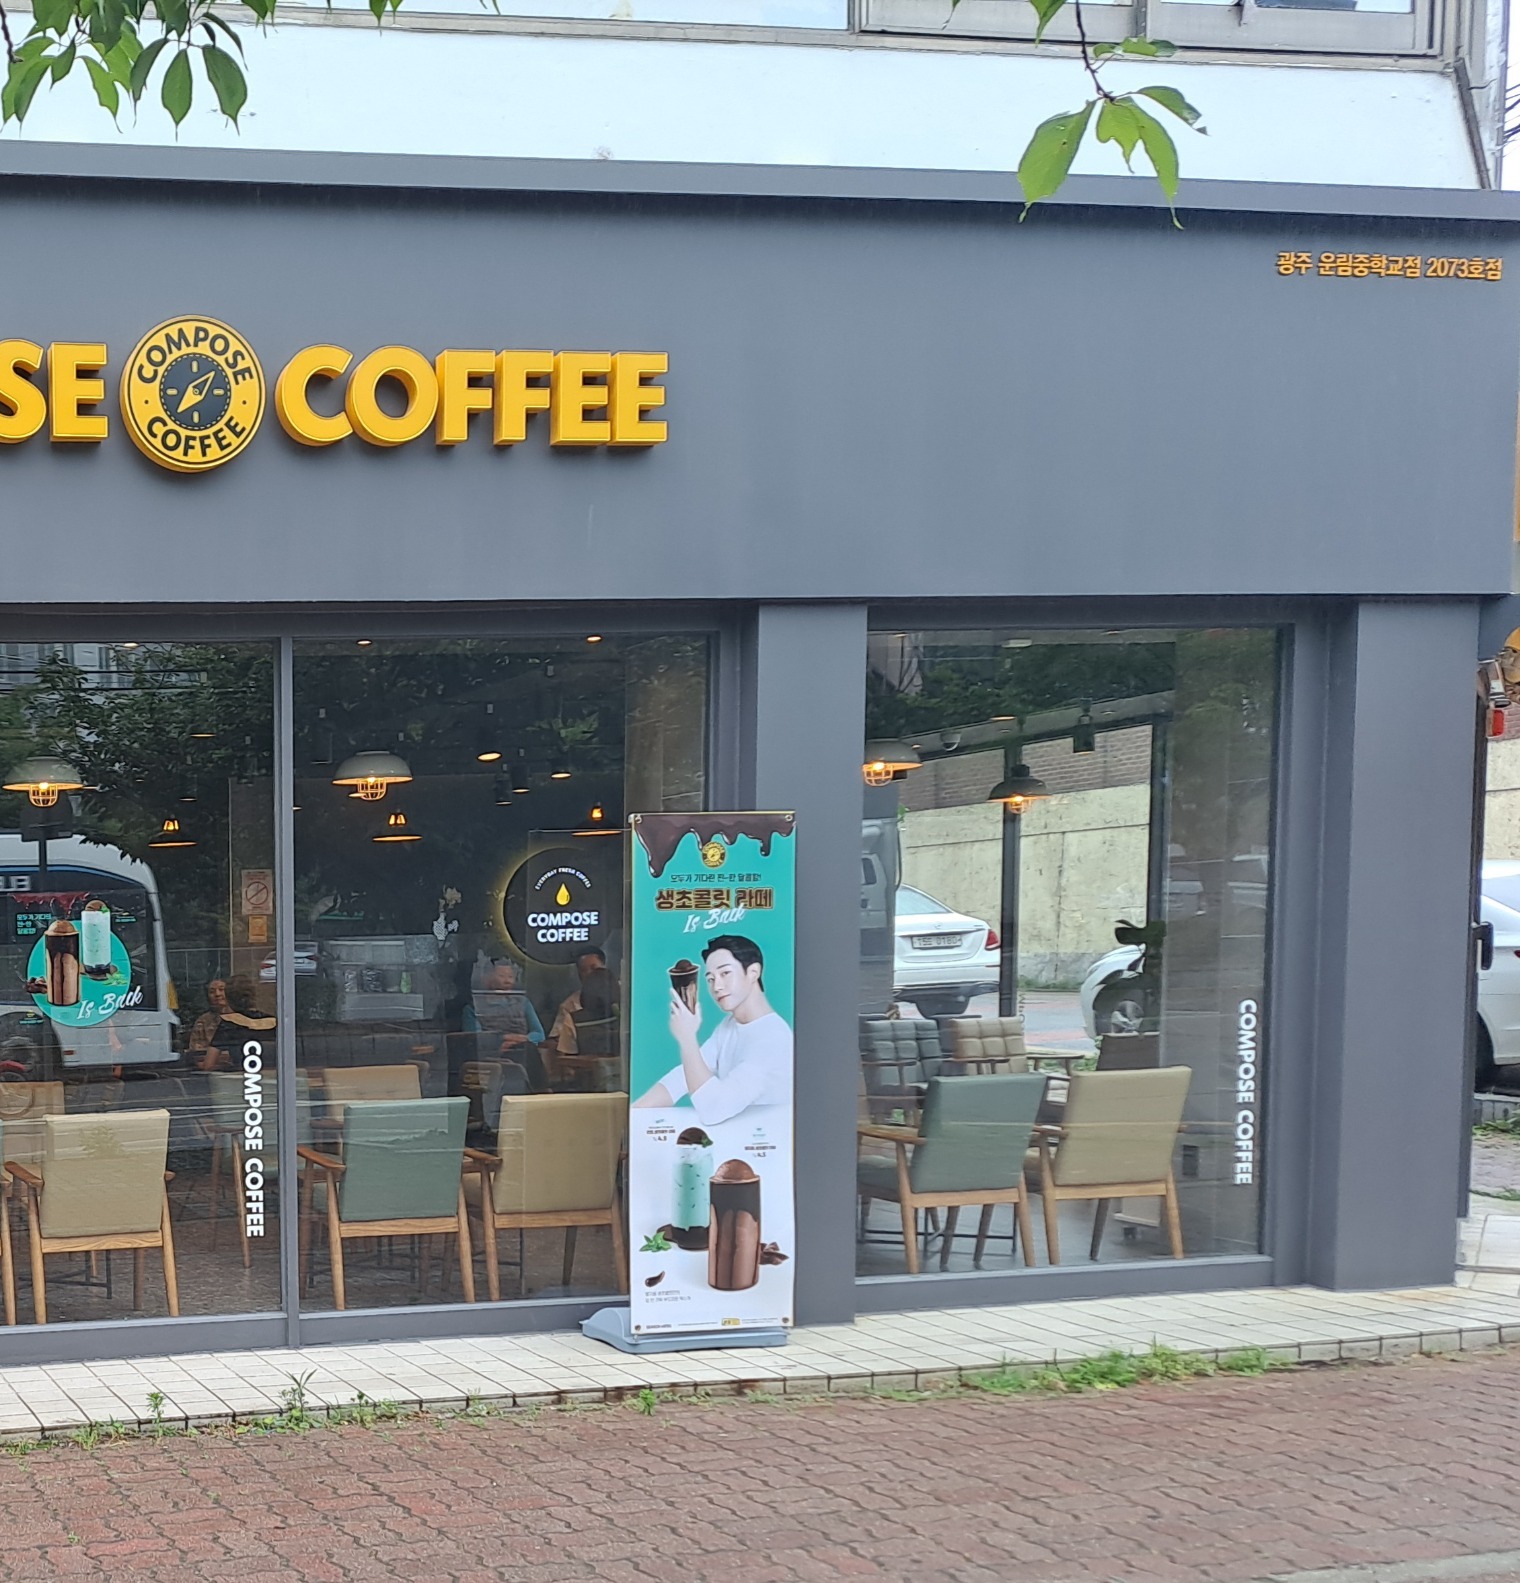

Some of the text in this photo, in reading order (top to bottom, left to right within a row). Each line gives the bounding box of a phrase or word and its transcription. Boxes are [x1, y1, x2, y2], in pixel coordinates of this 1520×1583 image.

[1277, 252, 1503, 281] 광주 운림중학교점 2073호점
[137, 326, 254, 385] COMPOSE
[275, 343, 670, 447] COFFEE
[147, 415, 246, 457] COFFEE
[656, 888, 774, 910] 생초콜릿 라떼
[527, 911, 599, 927] COMPOSE
[683, 903, 746, 933] Is Back
[537, 928, 589, 942] COFFEE
[77, 986, 143, 1019] Is Back
[1232, 999, 1258, 1185] COMPOSE COFFEE
[242, 1040, 265, 1237] COMPOSE COFFEE
